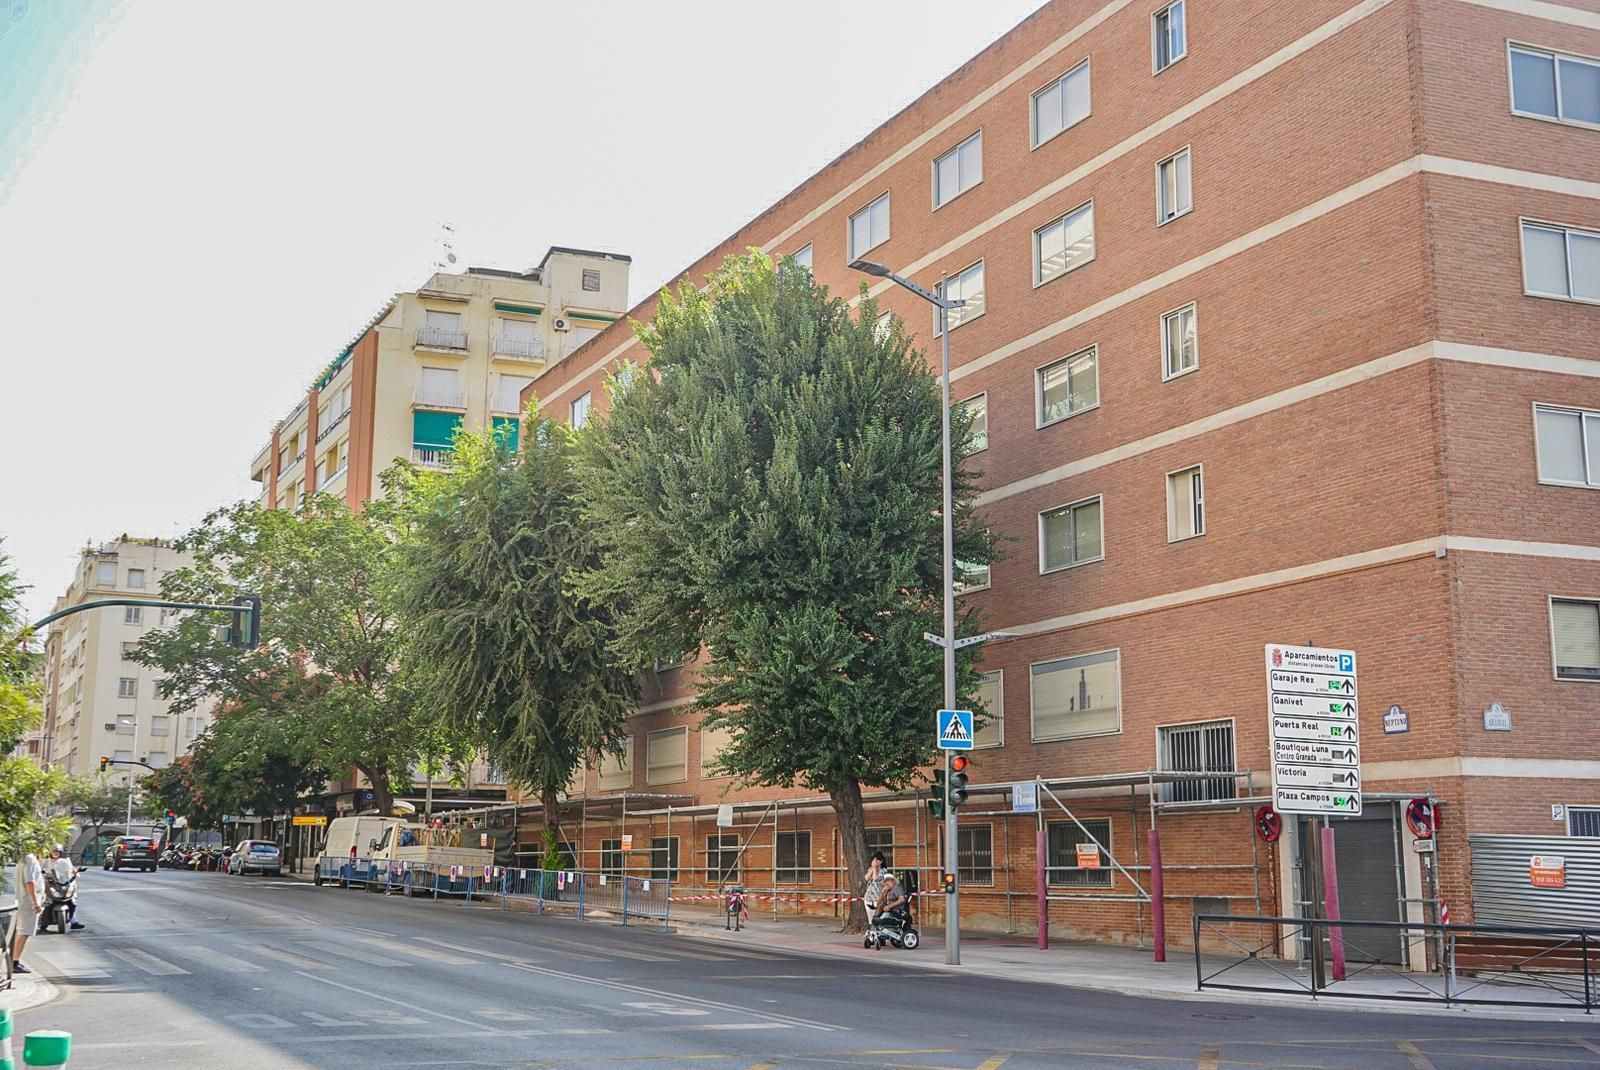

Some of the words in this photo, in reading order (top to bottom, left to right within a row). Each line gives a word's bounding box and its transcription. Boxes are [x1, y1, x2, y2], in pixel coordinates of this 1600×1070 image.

[1284, 651, 1338, 662] Aparcamientos
[1342, 656, 1351, 670] P
[1272, 673, 1298, 683] Garaje
[1300, 675, 1314, 683] Rex
[1274, 696, 1303, 706] Ganivet
[1275, 720, 1299, 729] Puerta
[1302, 721, 1319, 730] Real
[1276, 742, 1309, 752] Boutique
[1312, 745, 1329, 753] Luna
[1276, 752, 1294, 760] Centro
[1295, 753, 1317, 761] Granada
[1277, 767, 1307, 777] Victoria
[1278, 791, 1298, 800] Plaza
[1300, 792, 1330, 802] Campos
